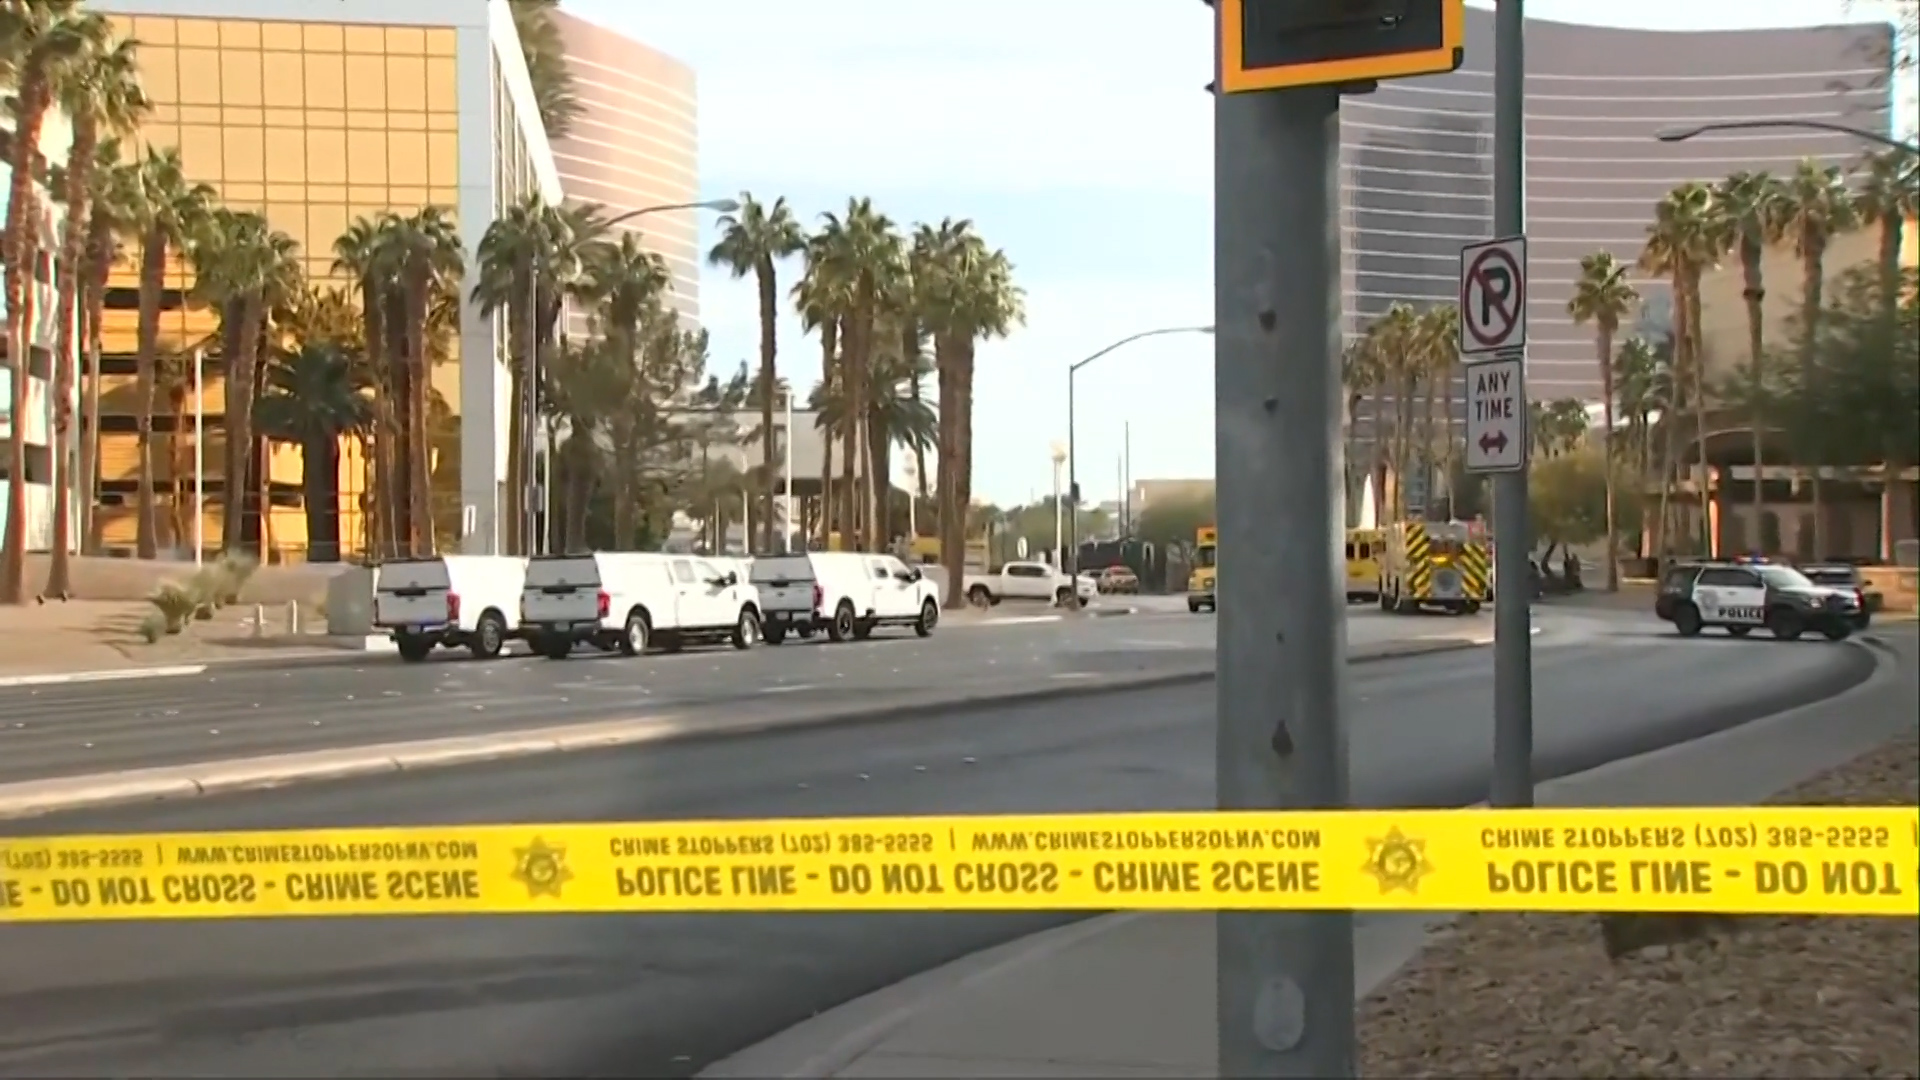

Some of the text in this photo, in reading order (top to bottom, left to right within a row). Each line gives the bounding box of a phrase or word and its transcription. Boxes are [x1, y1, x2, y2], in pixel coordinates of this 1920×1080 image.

[1476, 371, 1511, 394] ANY
[1475, 397, 1513, 421] TIME
[1718, 607, 1763, 618] POLICE
